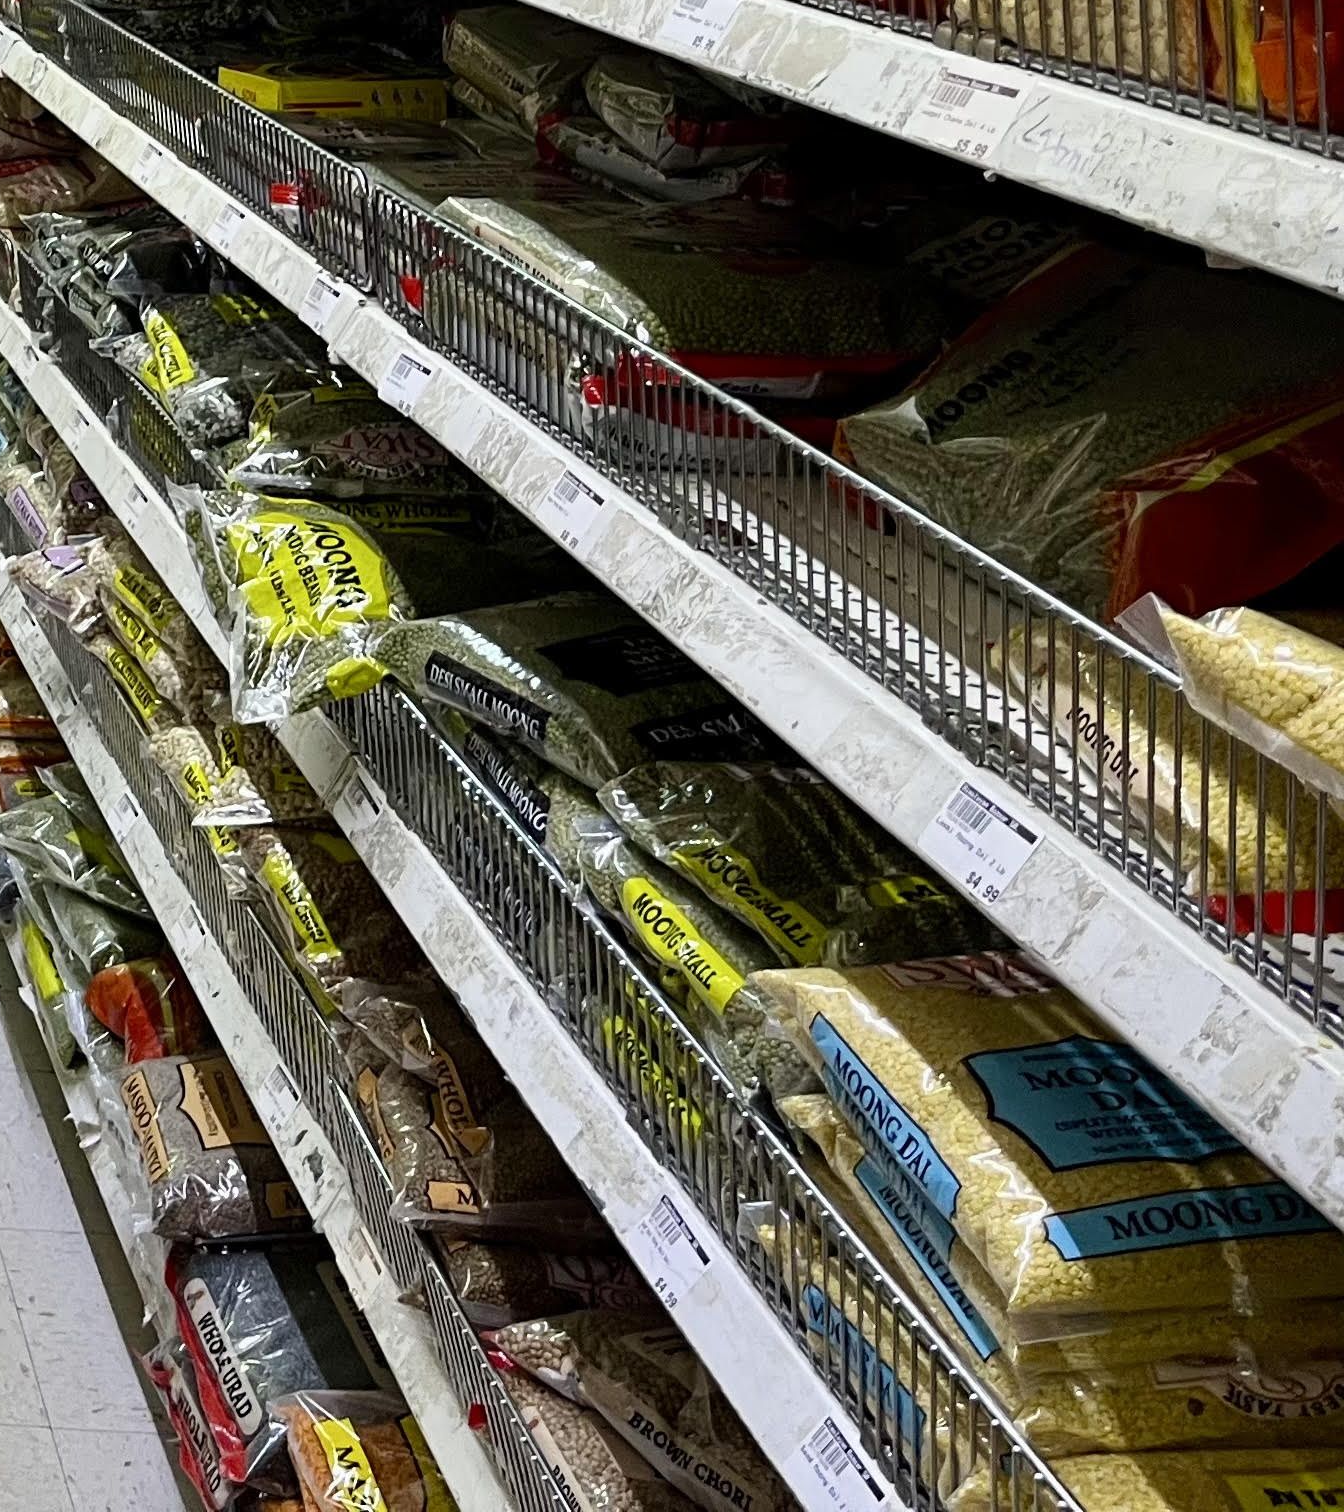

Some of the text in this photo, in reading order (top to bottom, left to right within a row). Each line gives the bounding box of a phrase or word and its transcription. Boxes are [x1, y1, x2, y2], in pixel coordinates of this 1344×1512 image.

[491, 698, 543, 742] MOONG
[505, 774, 548, 834] MOONG
[966, 871, 1001, 904] $4.99
[631, 892, 682, 952] MOONG
[832, 1050, 932, 1186] MOONG DAL
[1104, 1191, 1263, 1241] MOONG
[199, 1312, 253, 1421] WHOLE URAD
[627, 1410, 755, 1512] BROWN CHORI
